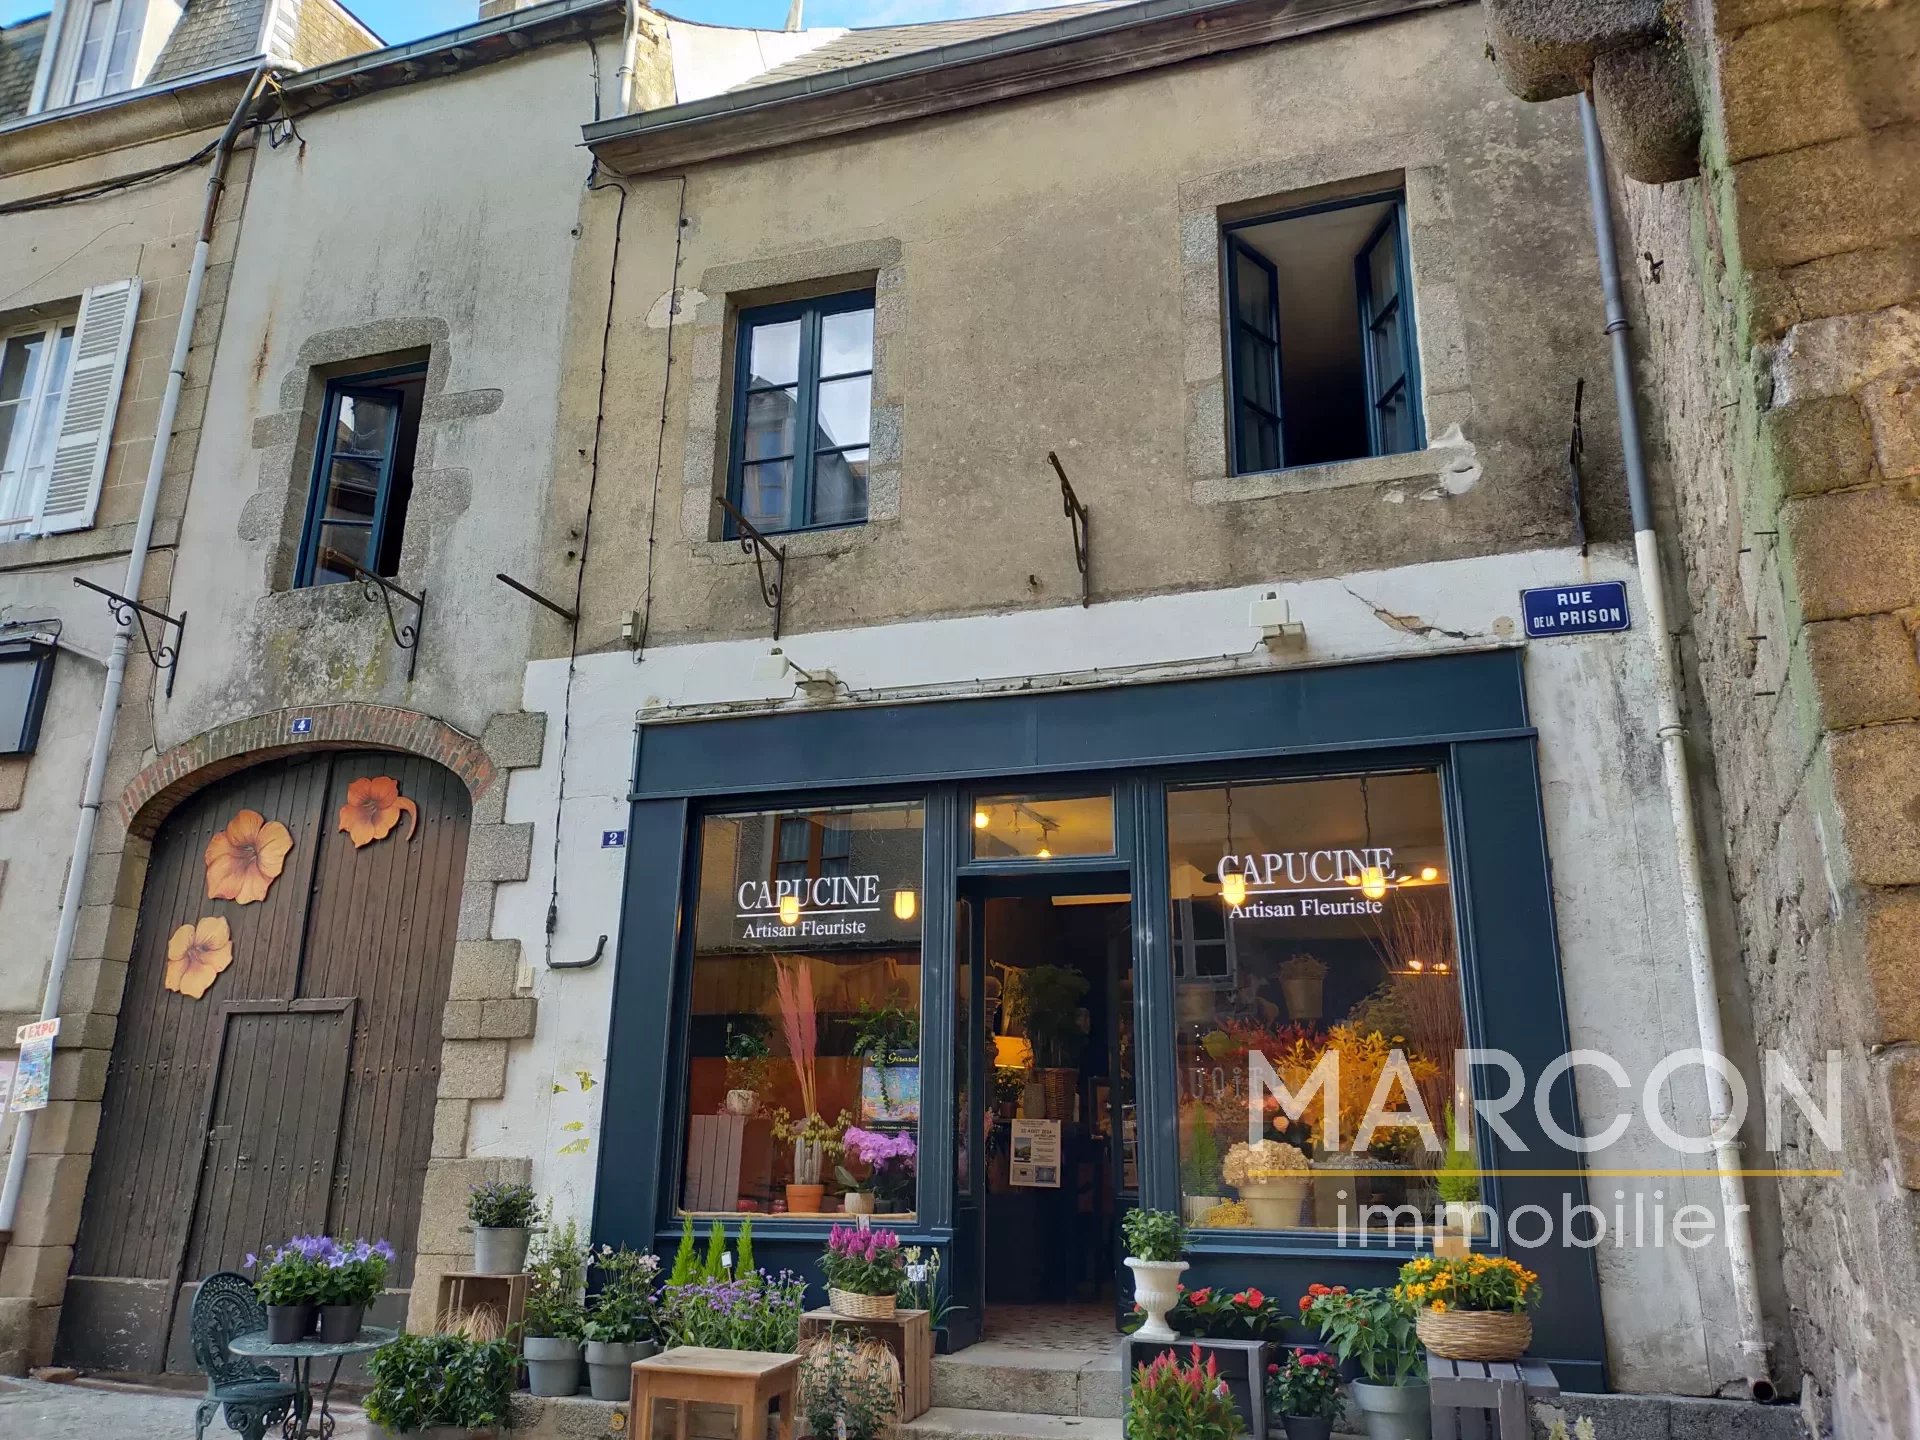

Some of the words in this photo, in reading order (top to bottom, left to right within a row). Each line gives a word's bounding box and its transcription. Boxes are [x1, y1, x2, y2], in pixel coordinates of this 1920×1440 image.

[1557, 591, 1593, 606] RUE
[1560, 607, 1621, 626] PRISON
[297, 719, 306, 731] 4
[609, 832, 618, 845] 2
[1217, 848, 1397, 885] CAPUCINE
[738, 875, 880, 910] CAPUCINE
[1229, 900, 1295, 919] Artisan
[1300, 897, 1383, 916] Fleuriste
[742, 922, 796, 939] Artisan
[801, 919, 866, 936] Fleuriste
[28, 1023, 56, 1038] EXPO
